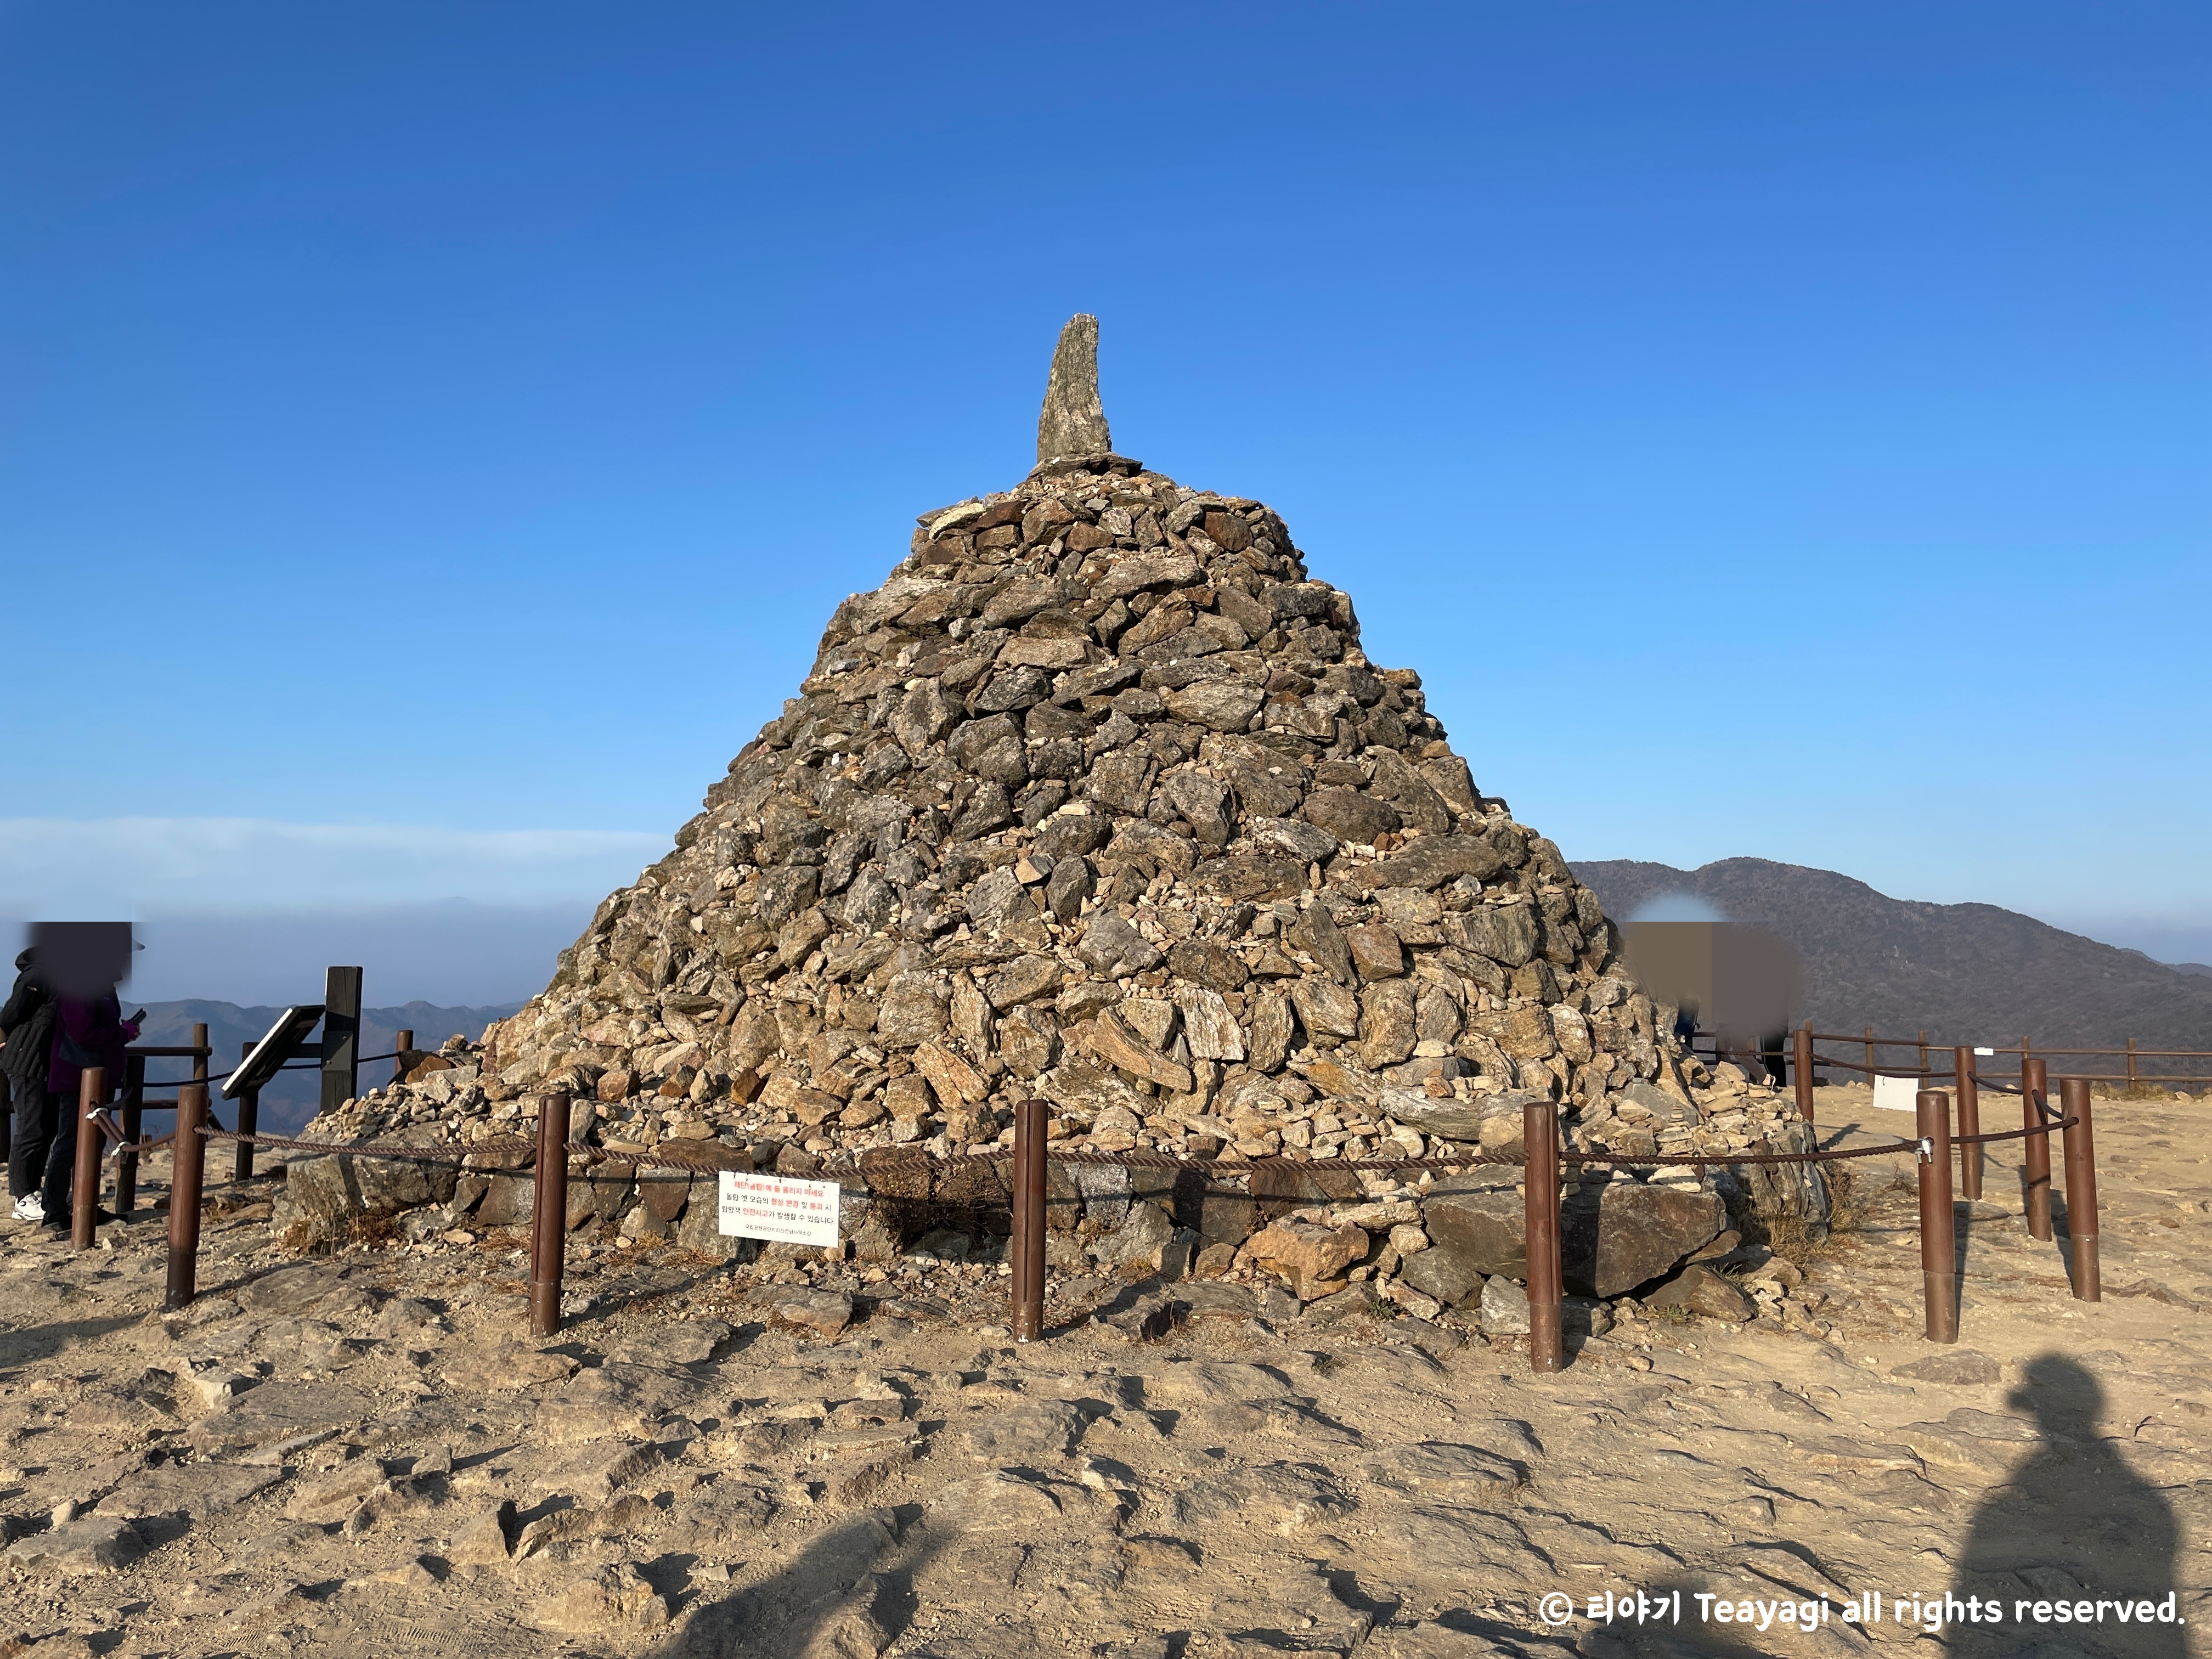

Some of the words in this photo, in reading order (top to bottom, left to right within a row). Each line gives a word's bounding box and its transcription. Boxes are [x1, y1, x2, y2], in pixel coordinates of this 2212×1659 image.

[783, 1186, 802, 1195] 올리지
[804, 1188, 824, 1197] 마세요
[749, 1196, 768, 1204] 모습의
[771, 1198, 783, 1206] 형상
[786, 1200, 799, 1208] 변경
[810, 1202, 823, 1211] 붕괴
[722, 1206, 741, 1214] 탐방객
[743, 1208, 775, 1218] 안전사고가
[777, 1212, 796, 1221] 발생할
[808, 1215, 835, 1224] 있습니다.
